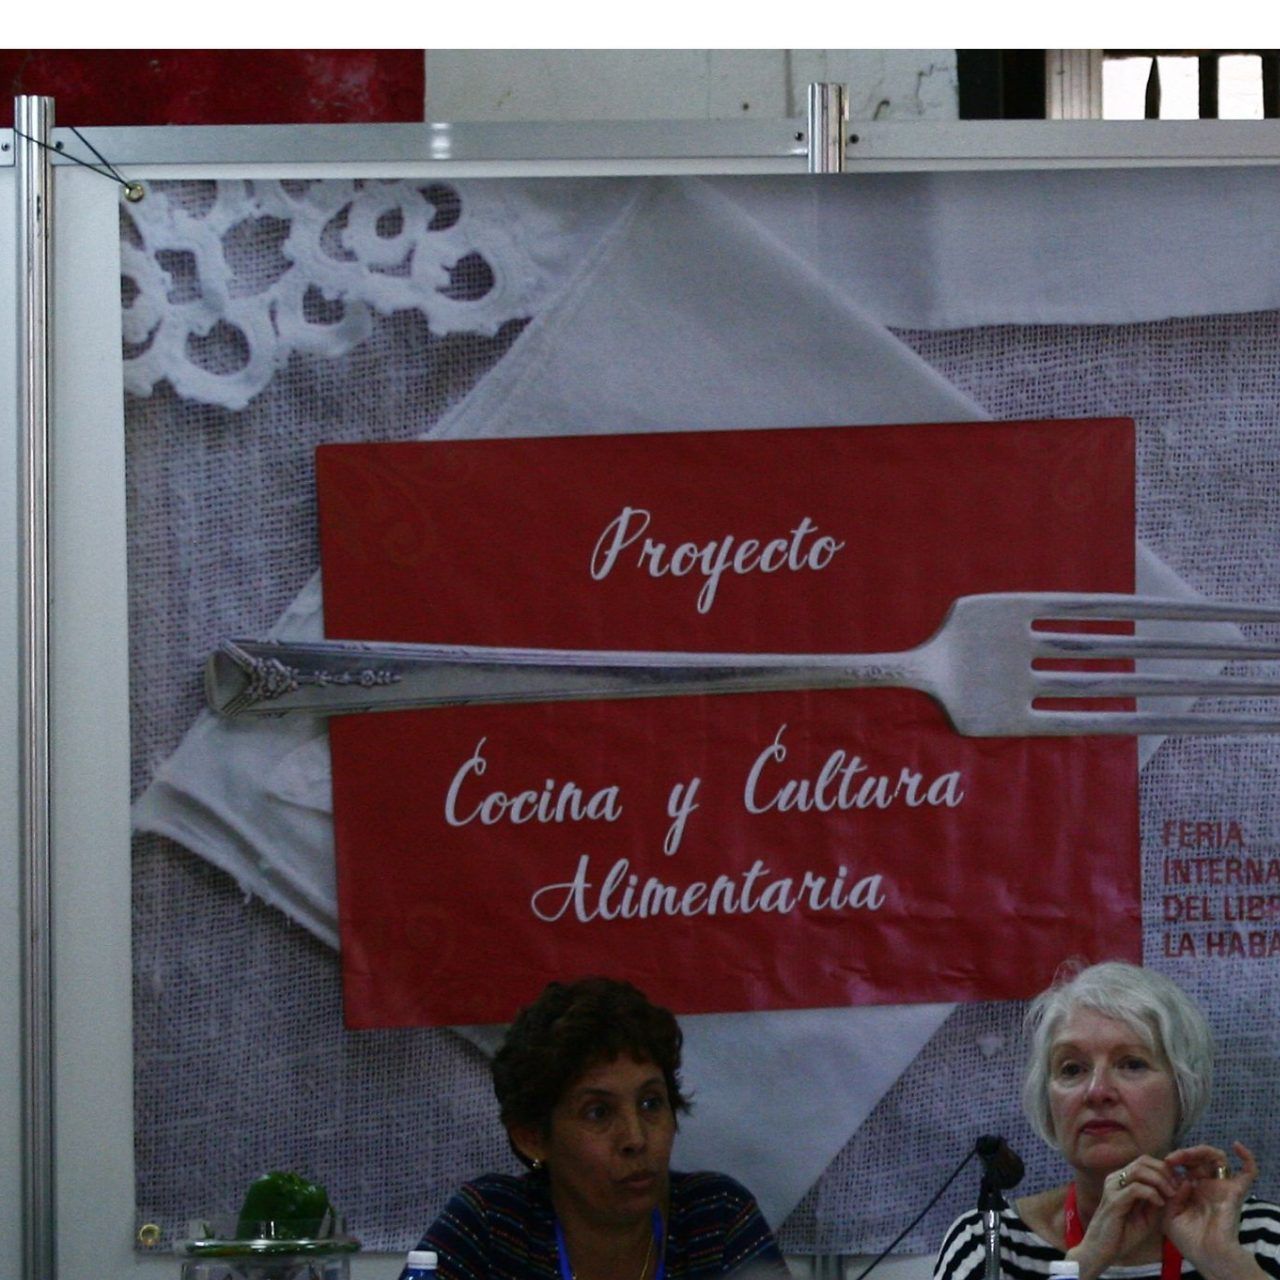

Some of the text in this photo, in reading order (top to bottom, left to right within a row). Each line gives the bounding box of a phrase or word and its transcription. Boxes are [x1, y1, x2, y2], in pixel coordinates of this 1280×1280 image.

[589, 505, 847, 616] Proyecto
[662, 776, 701, 857] y
[1162, 819, 1245, 848] FERIA
[530, 853, 887, 924] Alimentaria
[1163, 894, 1215, 923] DEL
[1164, 931, 1197, 958] LA
